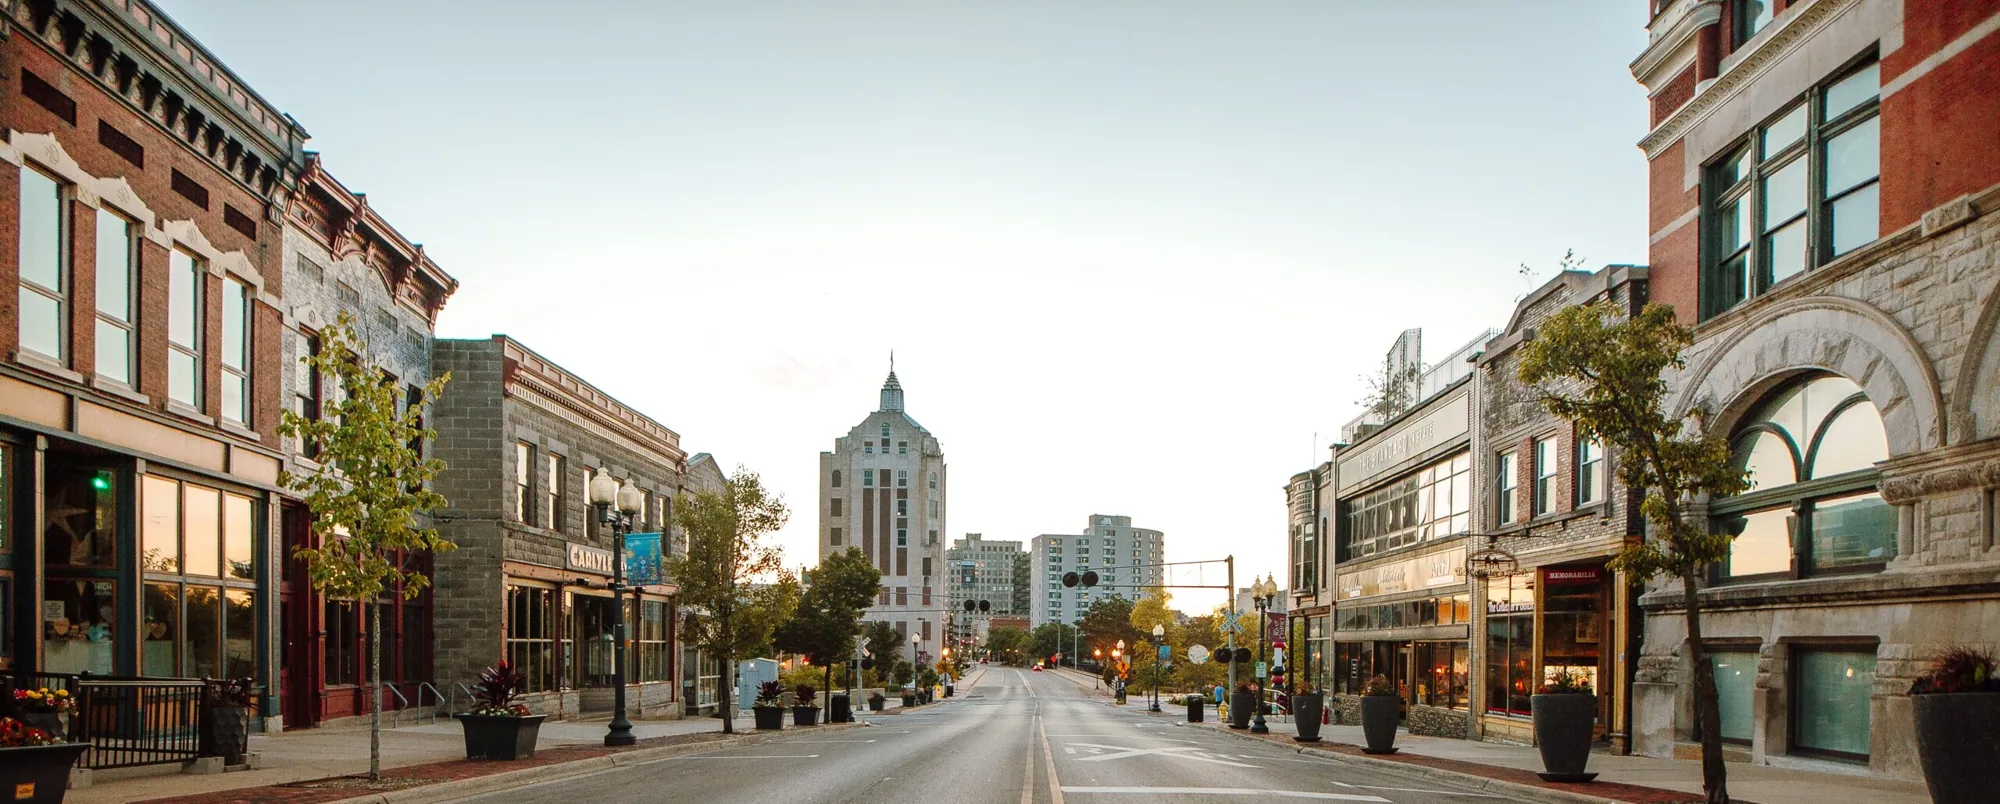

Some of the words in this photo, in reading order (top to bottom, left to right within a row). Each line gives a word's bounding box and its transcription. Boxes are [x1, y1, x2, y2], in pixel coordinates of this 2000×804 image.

[1360, 455, 1371, 474] THE
[1371, 434, 1409, 468] STANDARD
[1417, 423, 1435, 443] STATE
[570, 545, 613, 572] CARLYLE
[1549, 571, 1596, 579] MEMORABILIA
